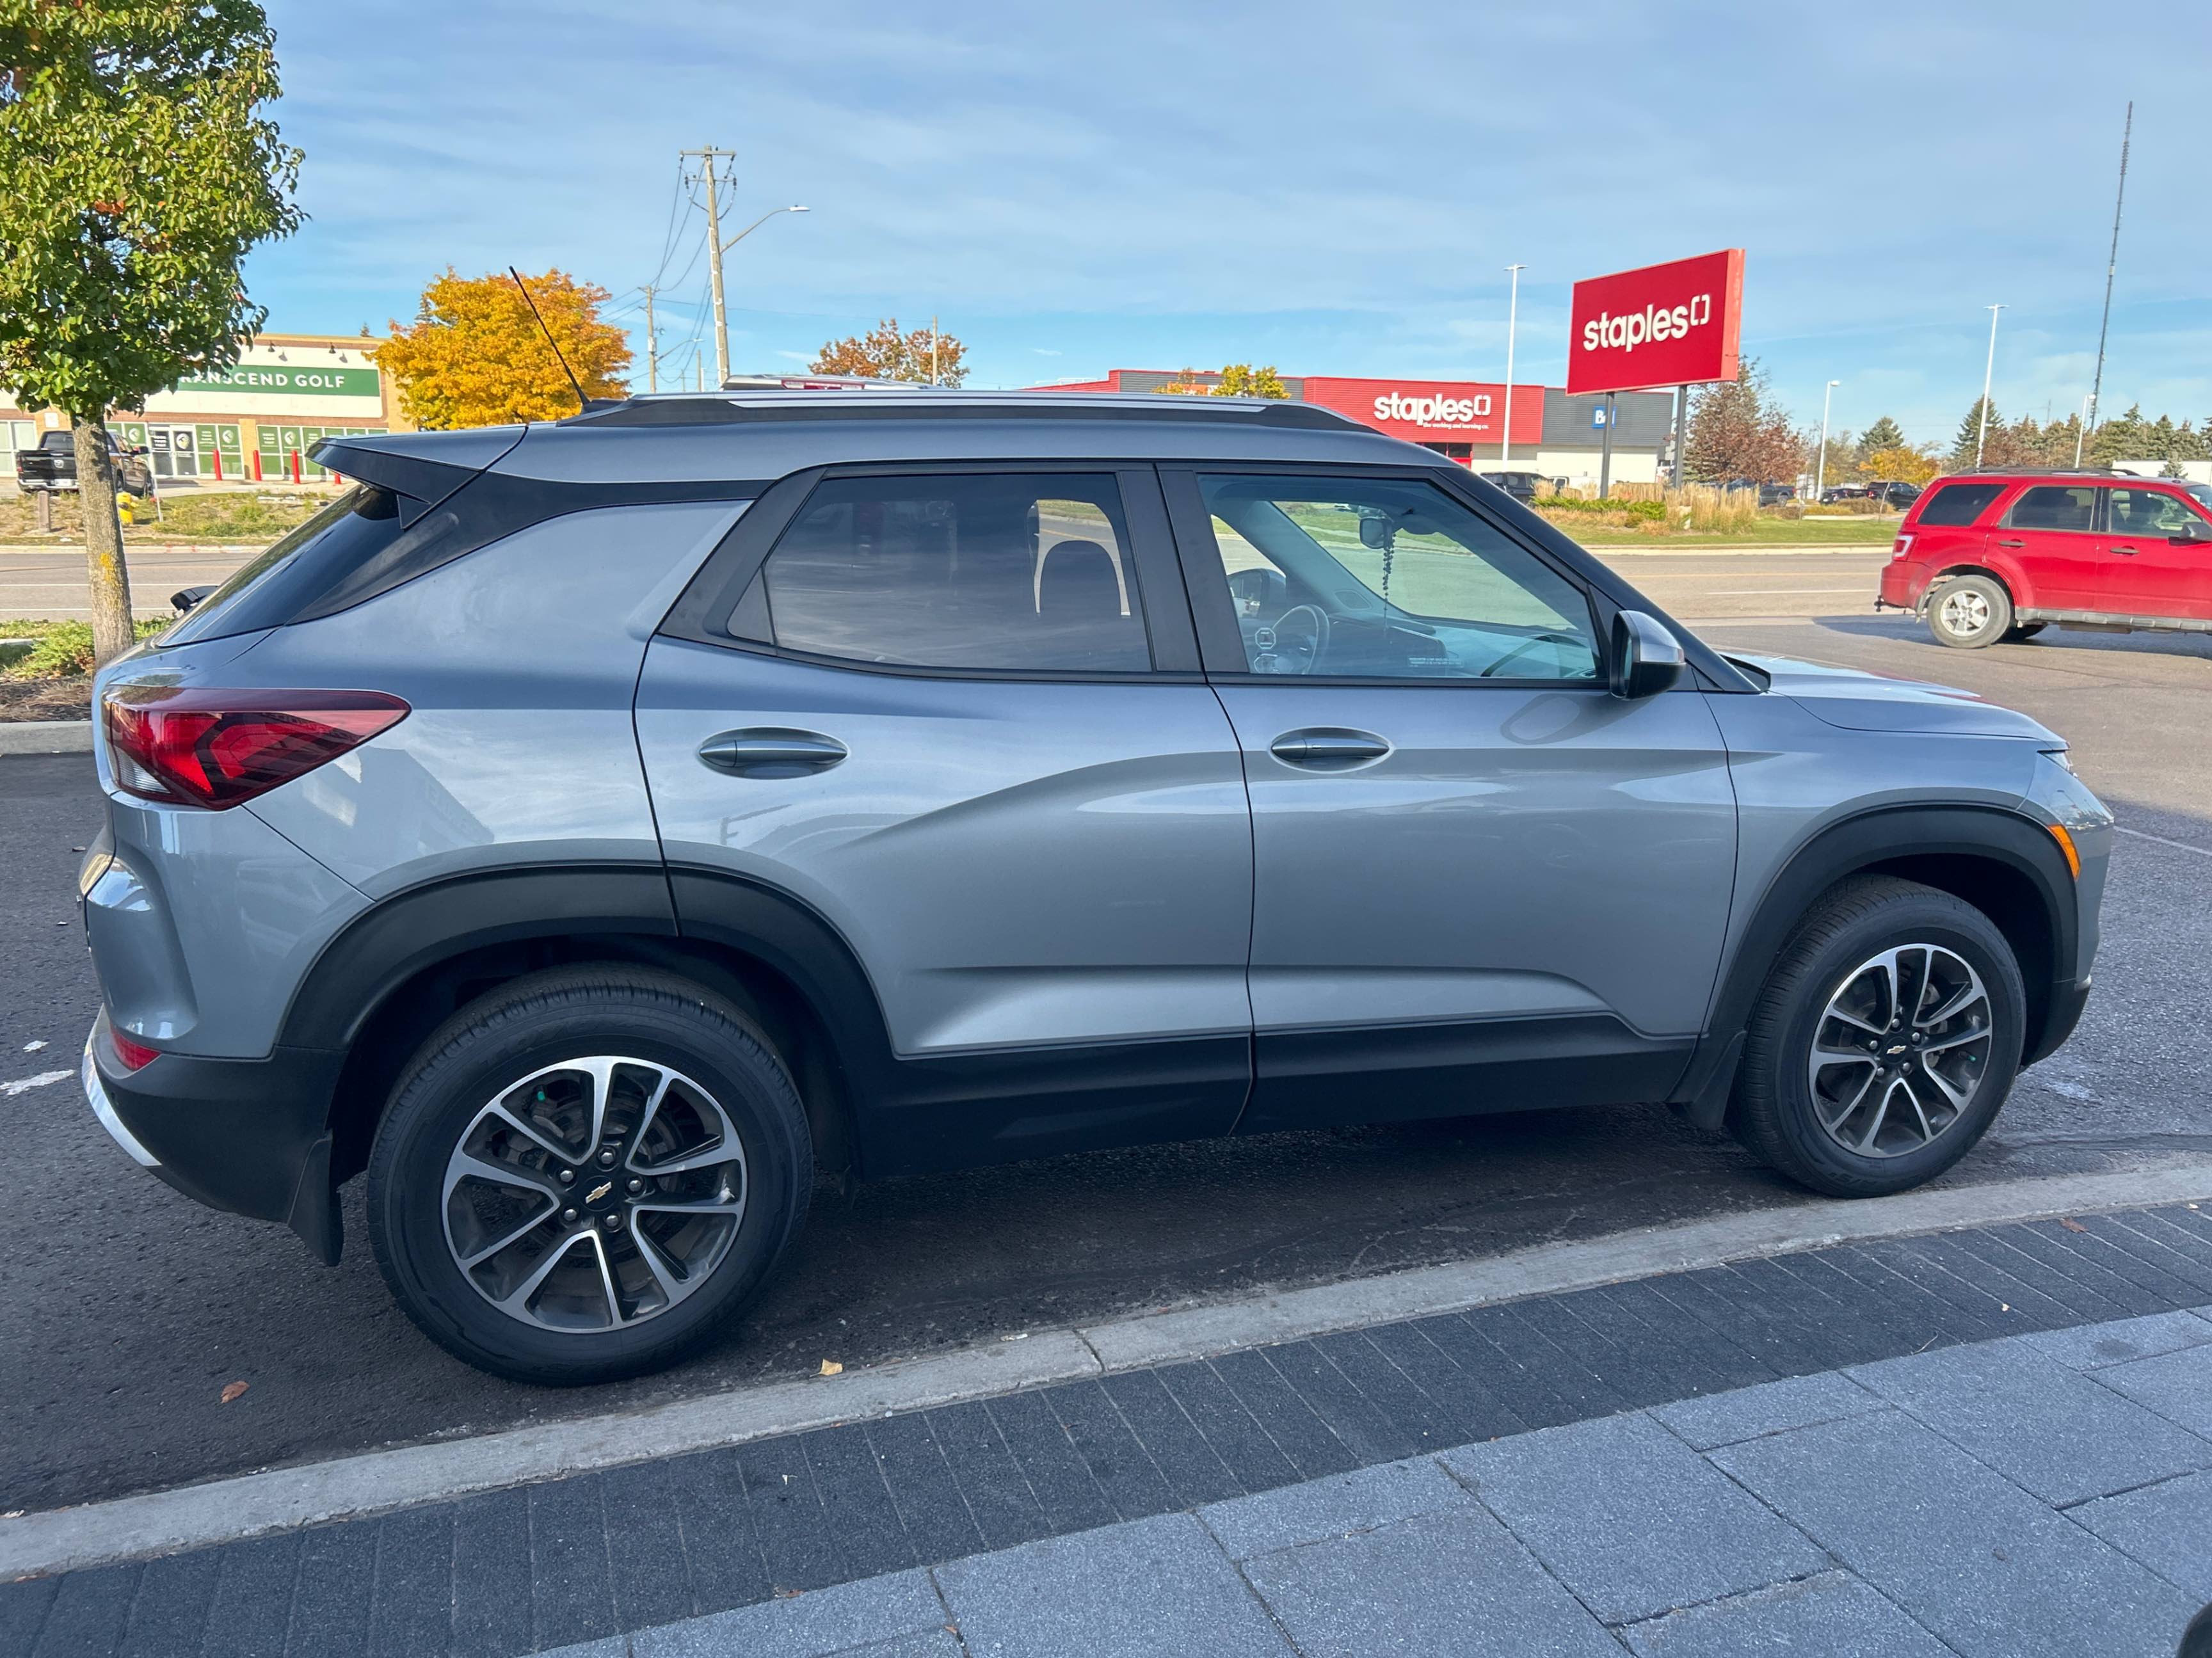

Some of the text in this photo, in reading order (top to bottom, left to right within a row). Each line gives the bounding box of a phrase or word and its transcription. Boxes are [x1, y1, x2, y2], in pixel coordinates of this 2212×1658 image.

[1583, 304, 1688, 353] staples
[294, 374, 345, 388] GOLF
[1374, 392, 1473, 426] staples
